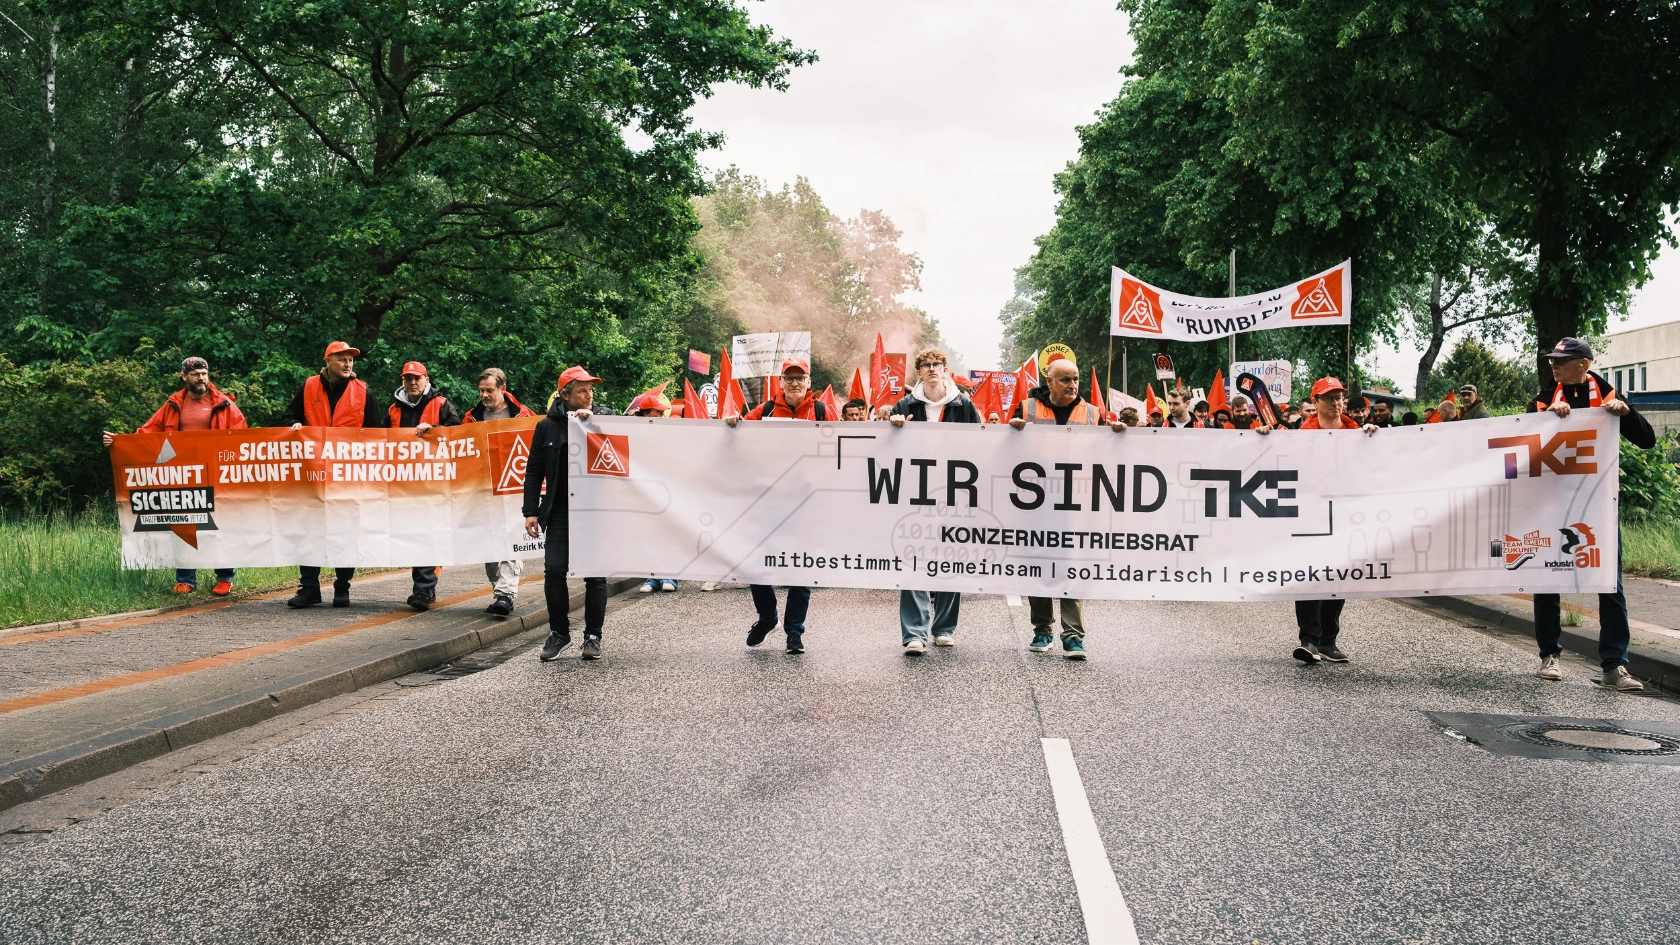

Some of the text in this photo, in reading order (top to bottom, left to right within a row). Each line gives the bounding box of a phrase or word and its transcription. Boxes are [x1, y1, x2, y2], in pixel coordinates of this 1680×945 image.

[1046, 345, 1070, 355] KONE?
[218, 436, 481, 462] FÜR SICHERE ARBEITSPLÄTZE,
[1488, 429, 1598, 479] TKE
[125, 464, 204, 487] ZUKUNFT
[219, 462, 457, 484] ZUKUNFT UND EINKOMMEN
[867, 457, 1299, 518] WIR SIND TKE
[131, 489, 213, 511] SICHERN.
[513, 542, 537, 553] Bezirk
[941, 525, 1200, 552] KONZERNBETRIEBSRAT
[764, 552, 1392, 586] mitbestimmt gemeinsam solidarisch respektvoll
